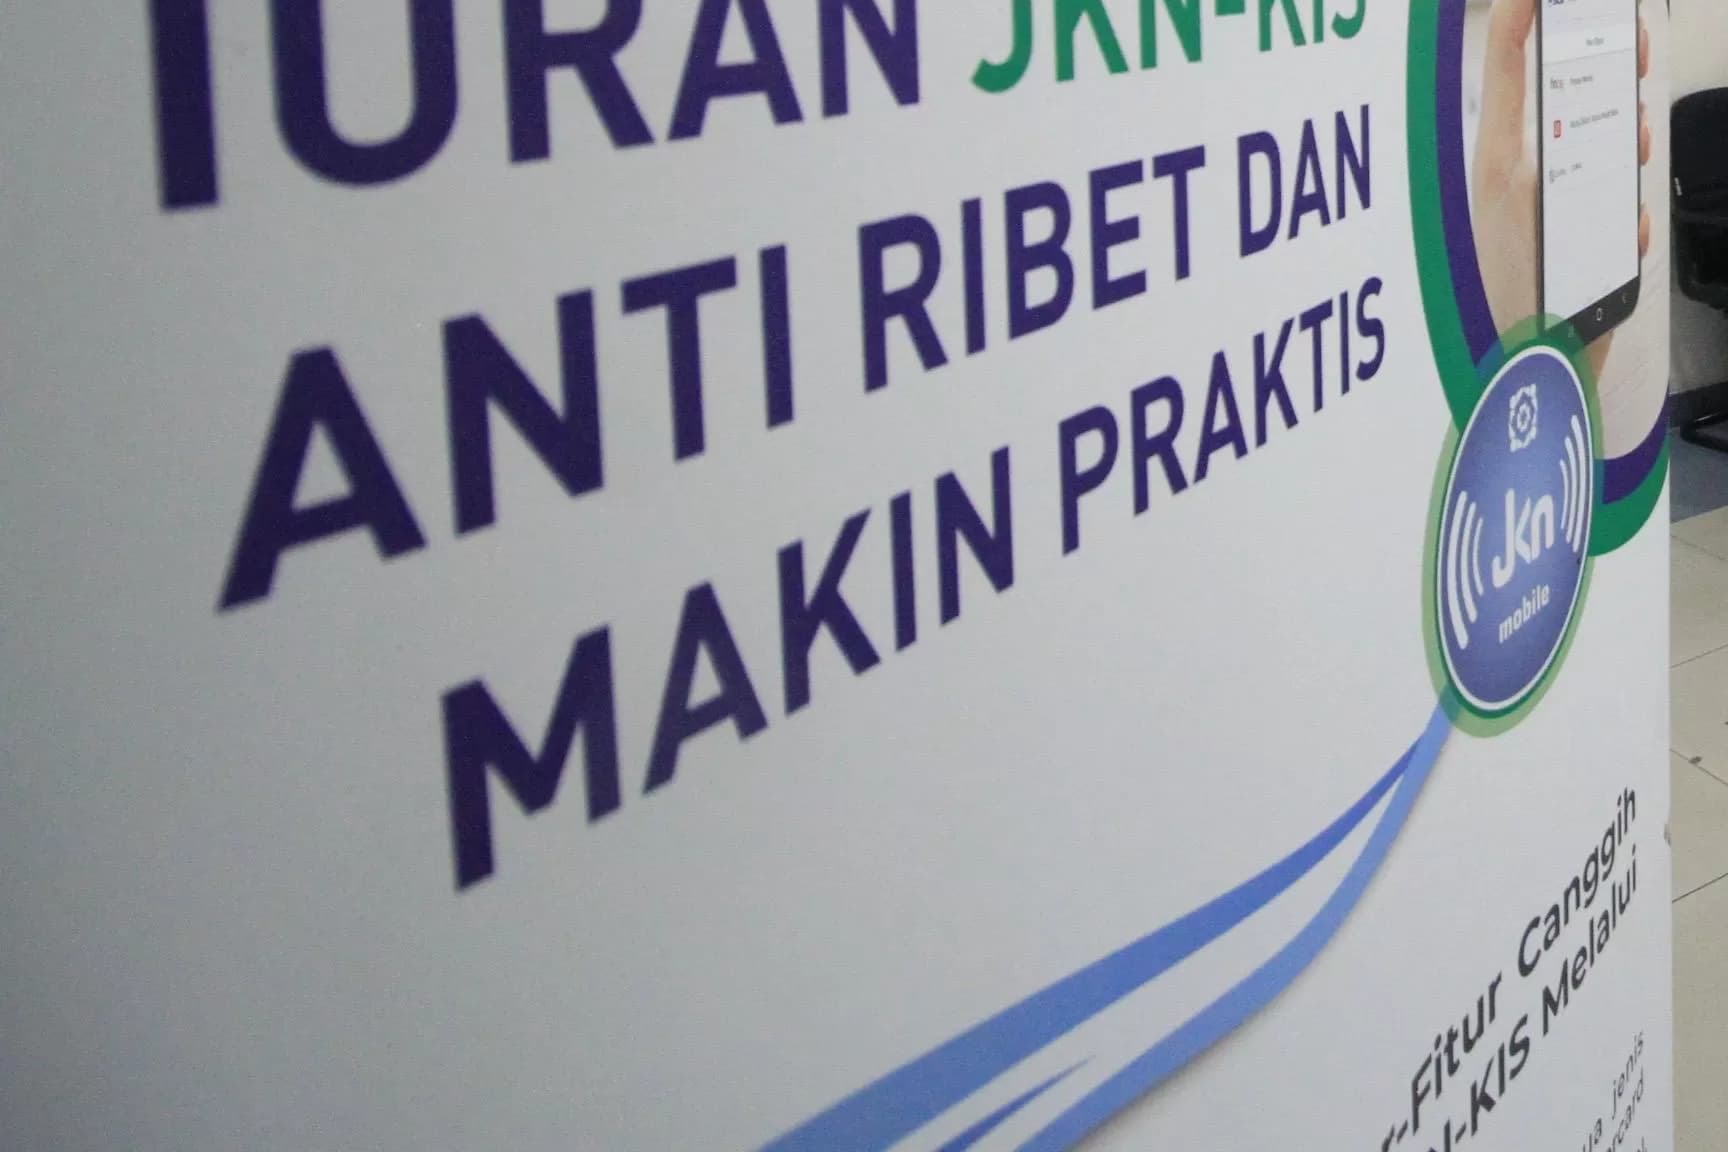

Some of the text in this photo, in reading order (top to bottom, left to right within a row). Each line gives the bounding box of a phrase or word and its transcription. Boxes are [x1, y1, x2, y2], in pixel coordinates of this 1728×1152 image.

[215, 103, 1373, 615] ANTI RIBET DAN
[440, 276, 1386, 894] MAKIN PRAKTIS
[1499, 584, 1551, 644] mobile
[1517, 786, 1636, 978] Canggih
[1541, 844, 1637, 1037] Melalui
[1609, 1029, 1644, 1121] jenis
